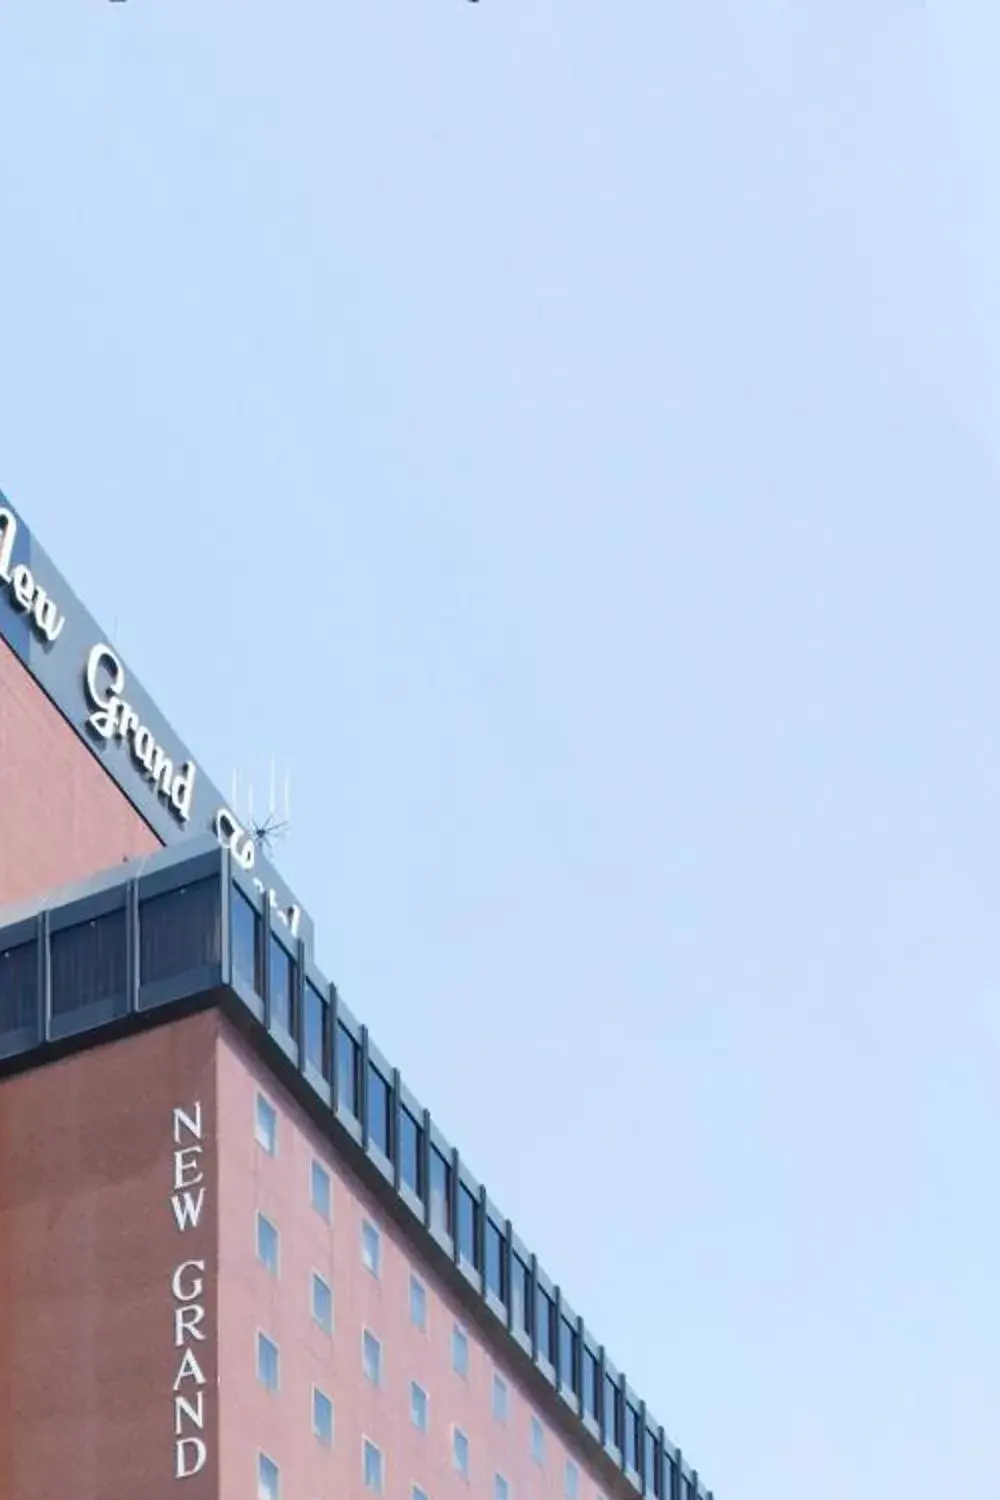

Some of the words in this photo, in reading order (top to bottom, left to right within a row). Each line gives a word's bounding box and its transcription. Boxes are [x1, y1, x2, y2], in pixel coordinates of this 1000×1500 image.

[87, 643, 195, 822] Grand
[171, 1101, 207, 1231] NEW
[171, 1260, 207, 1479] GRAND
